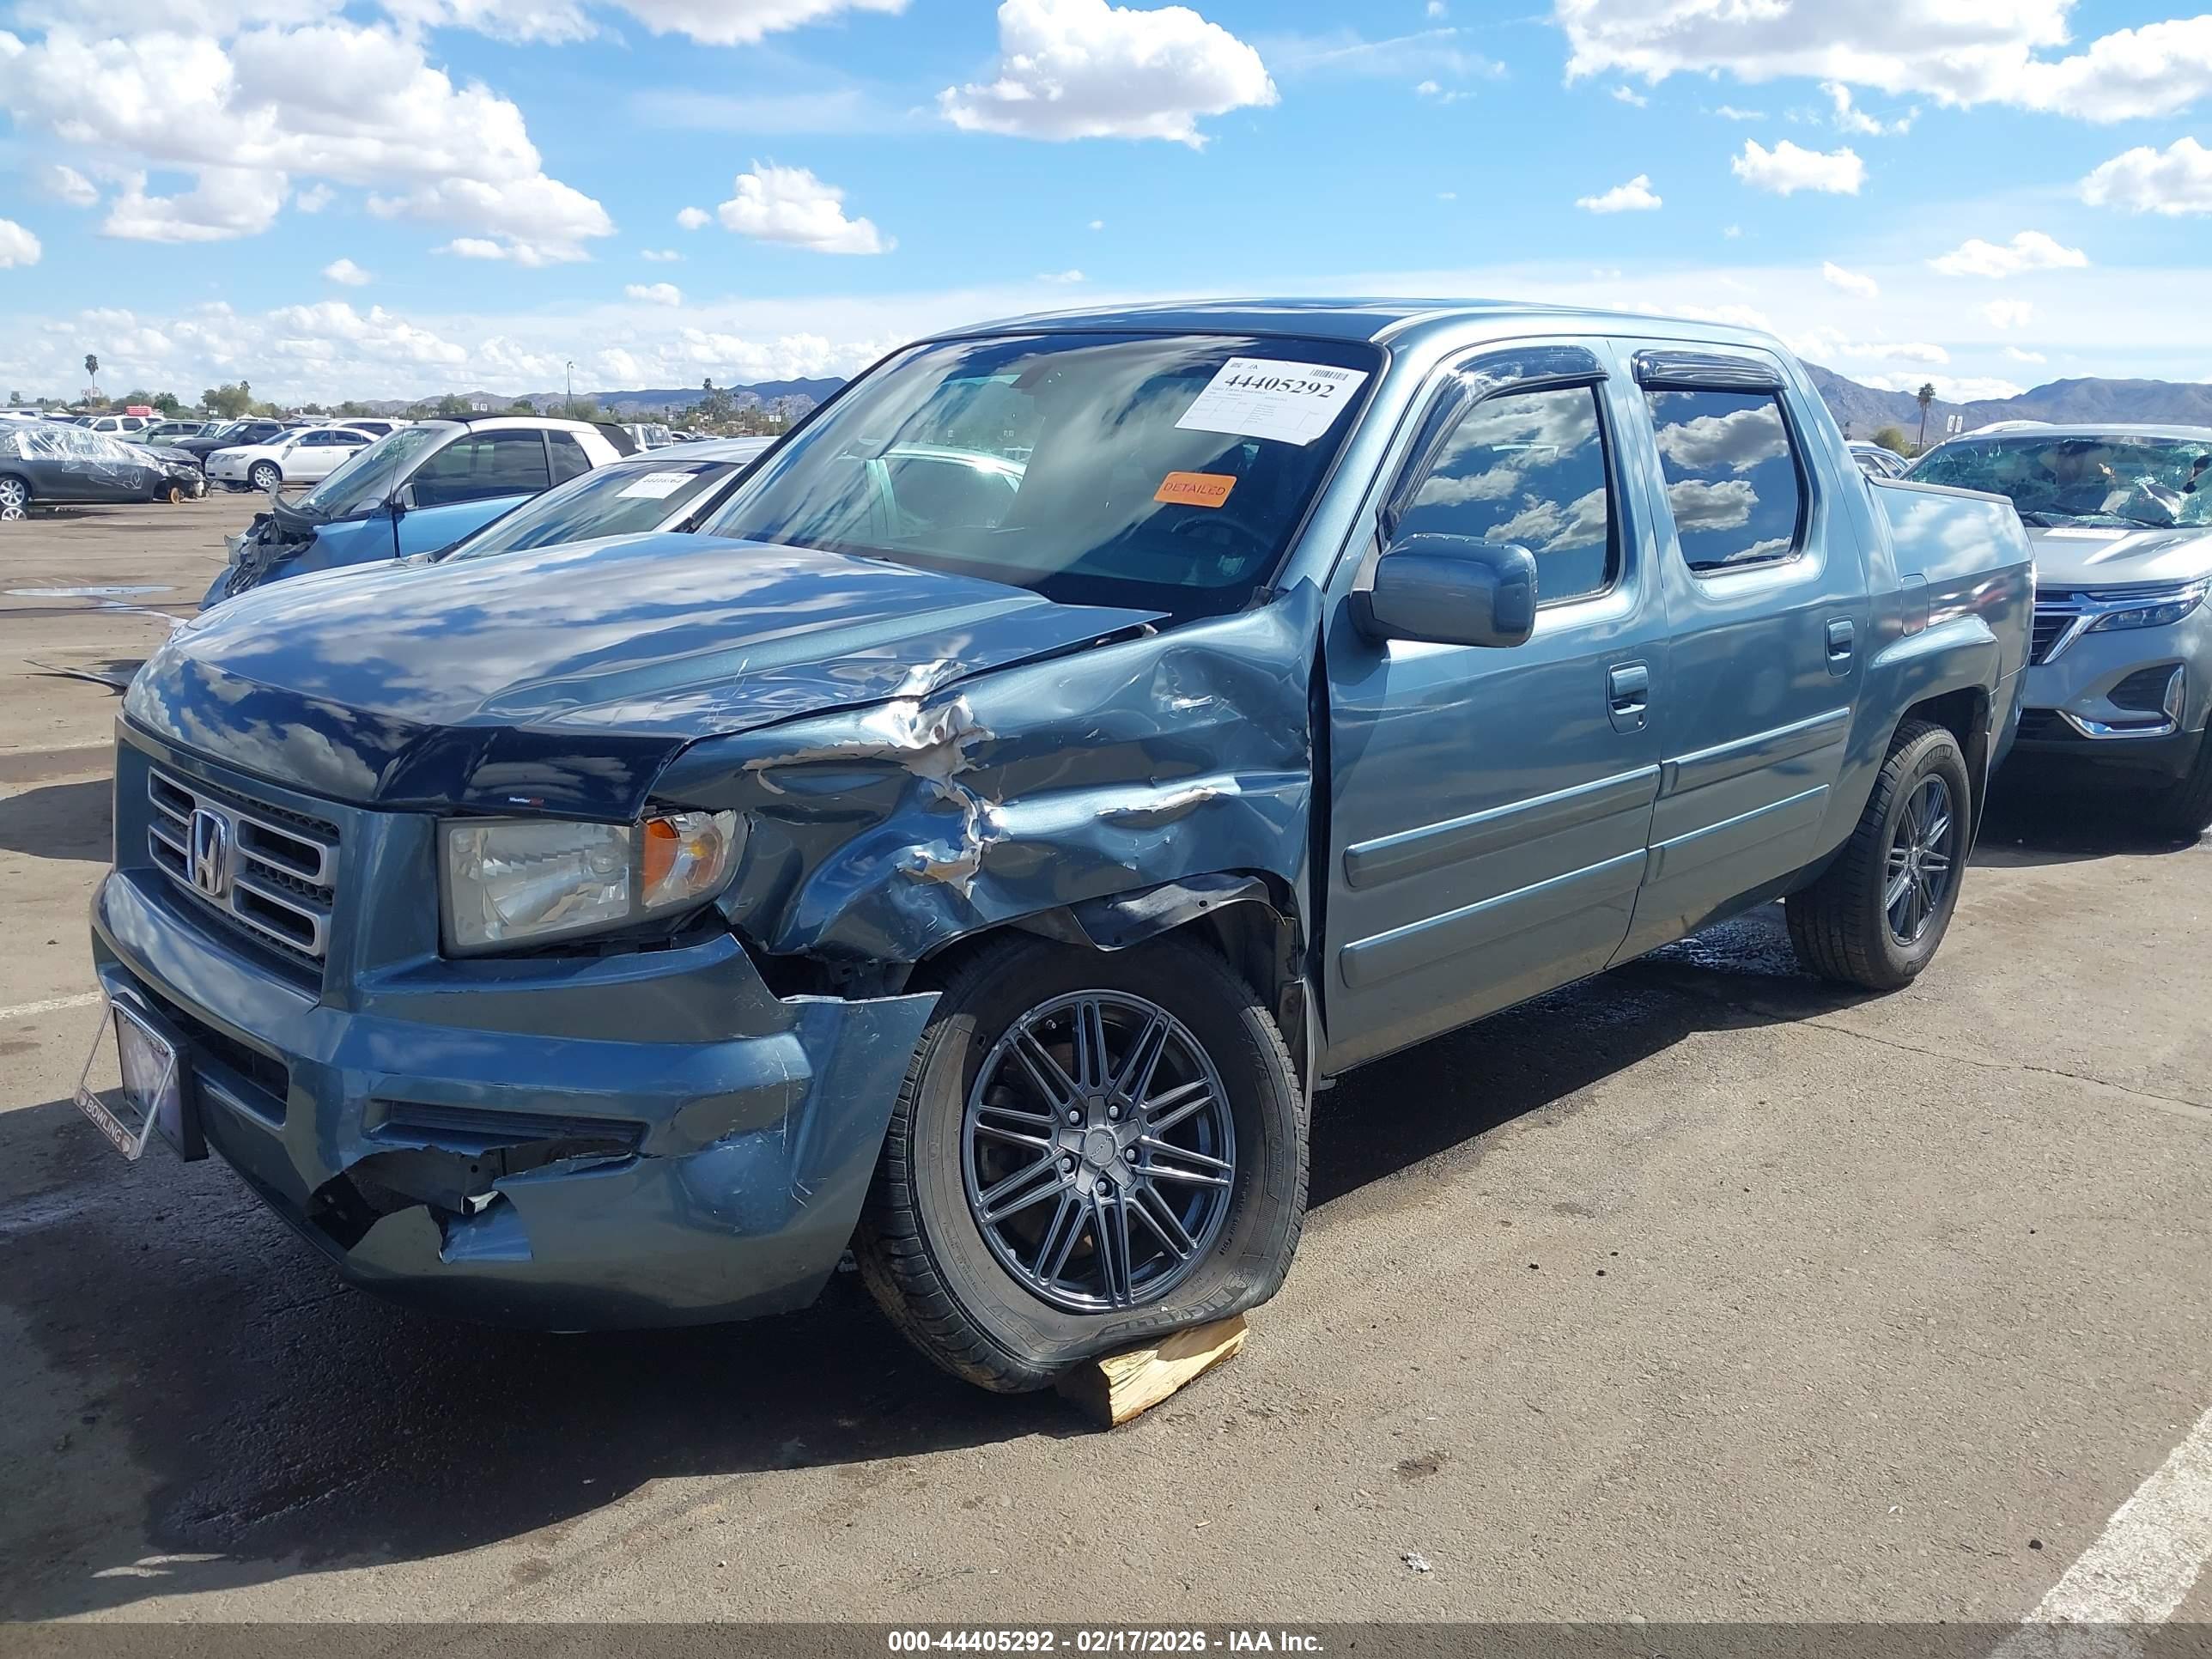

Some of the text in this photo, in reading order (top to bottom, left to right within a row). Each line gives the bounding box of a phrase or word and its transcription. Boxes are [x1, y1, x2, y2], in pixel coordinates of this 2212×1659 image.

[1224, 374, 1335, 398] 44405292
[1164, 482, 1226, 495] DETAILED
[85, 1098, 122, 1142] BOWLING
[1104, 1290, 1234, 1334] MICHELIN
